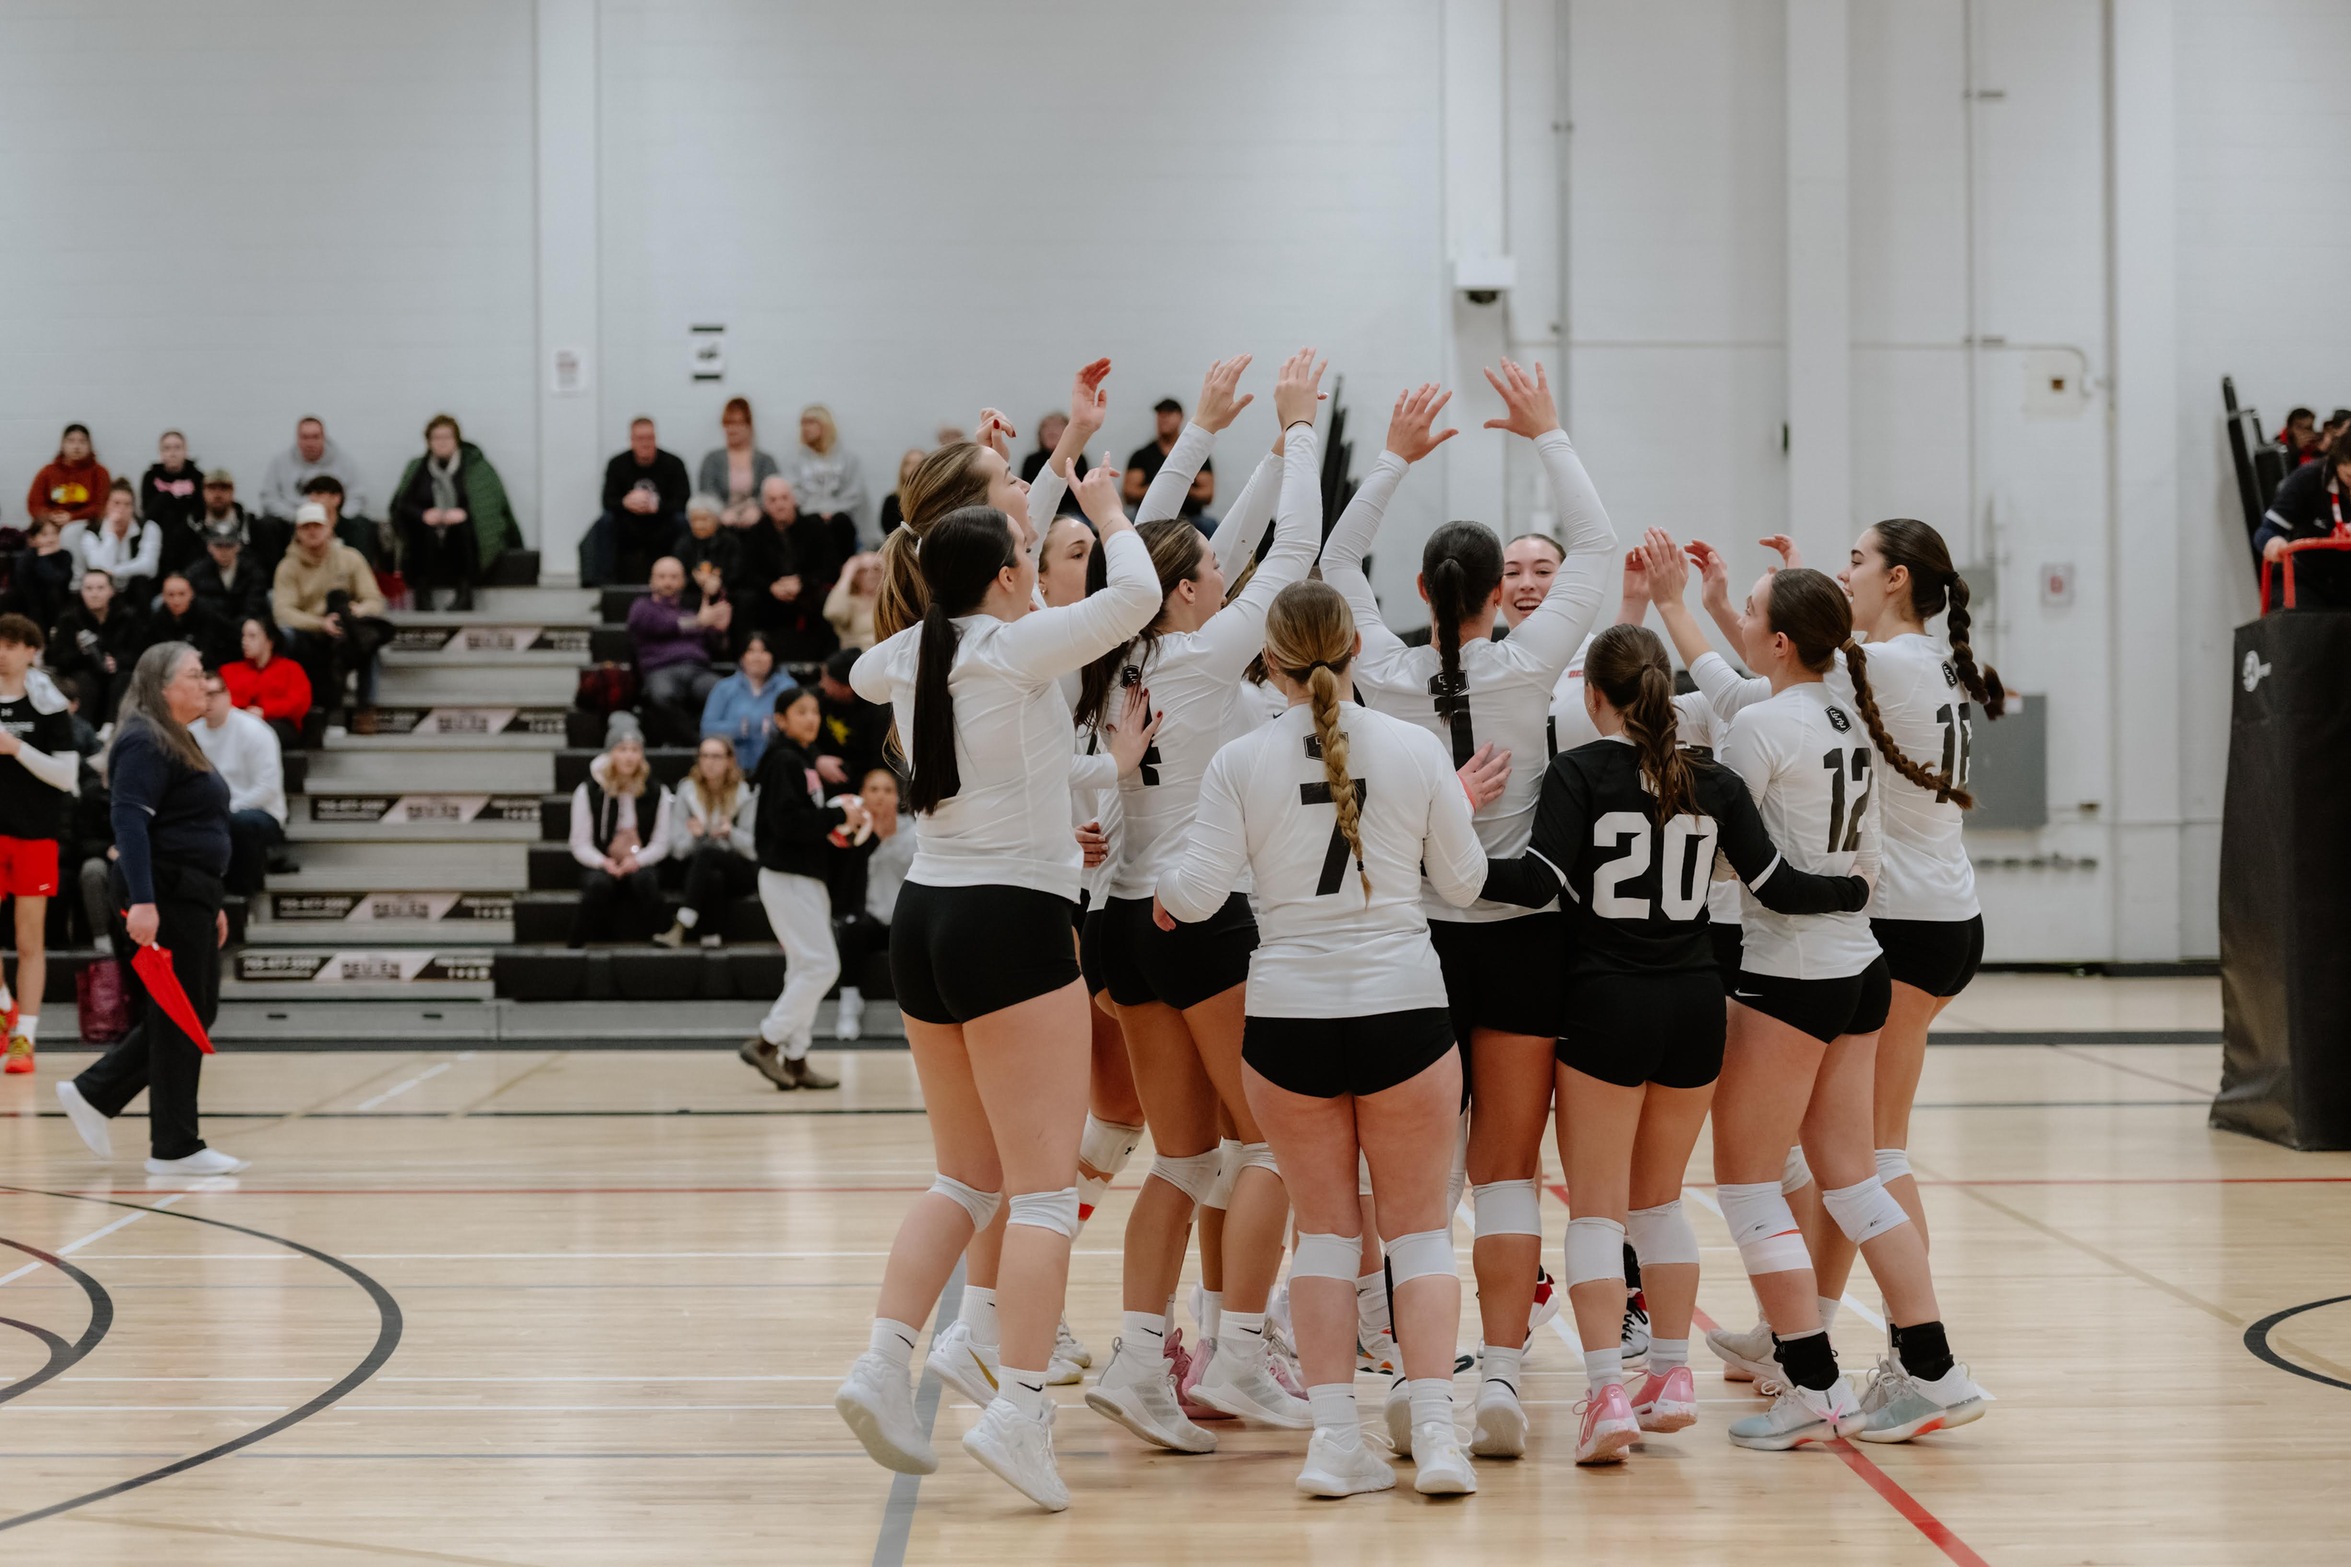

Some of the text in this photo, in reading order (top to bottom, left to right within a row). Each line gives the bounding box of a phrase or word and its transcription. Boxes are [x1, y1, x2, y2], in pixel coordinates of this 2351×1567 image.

[1299, 777, 1367, 896] 7
[1823, 747, 1874, 853] 12
[1592, 811, 1718, 921] 20
